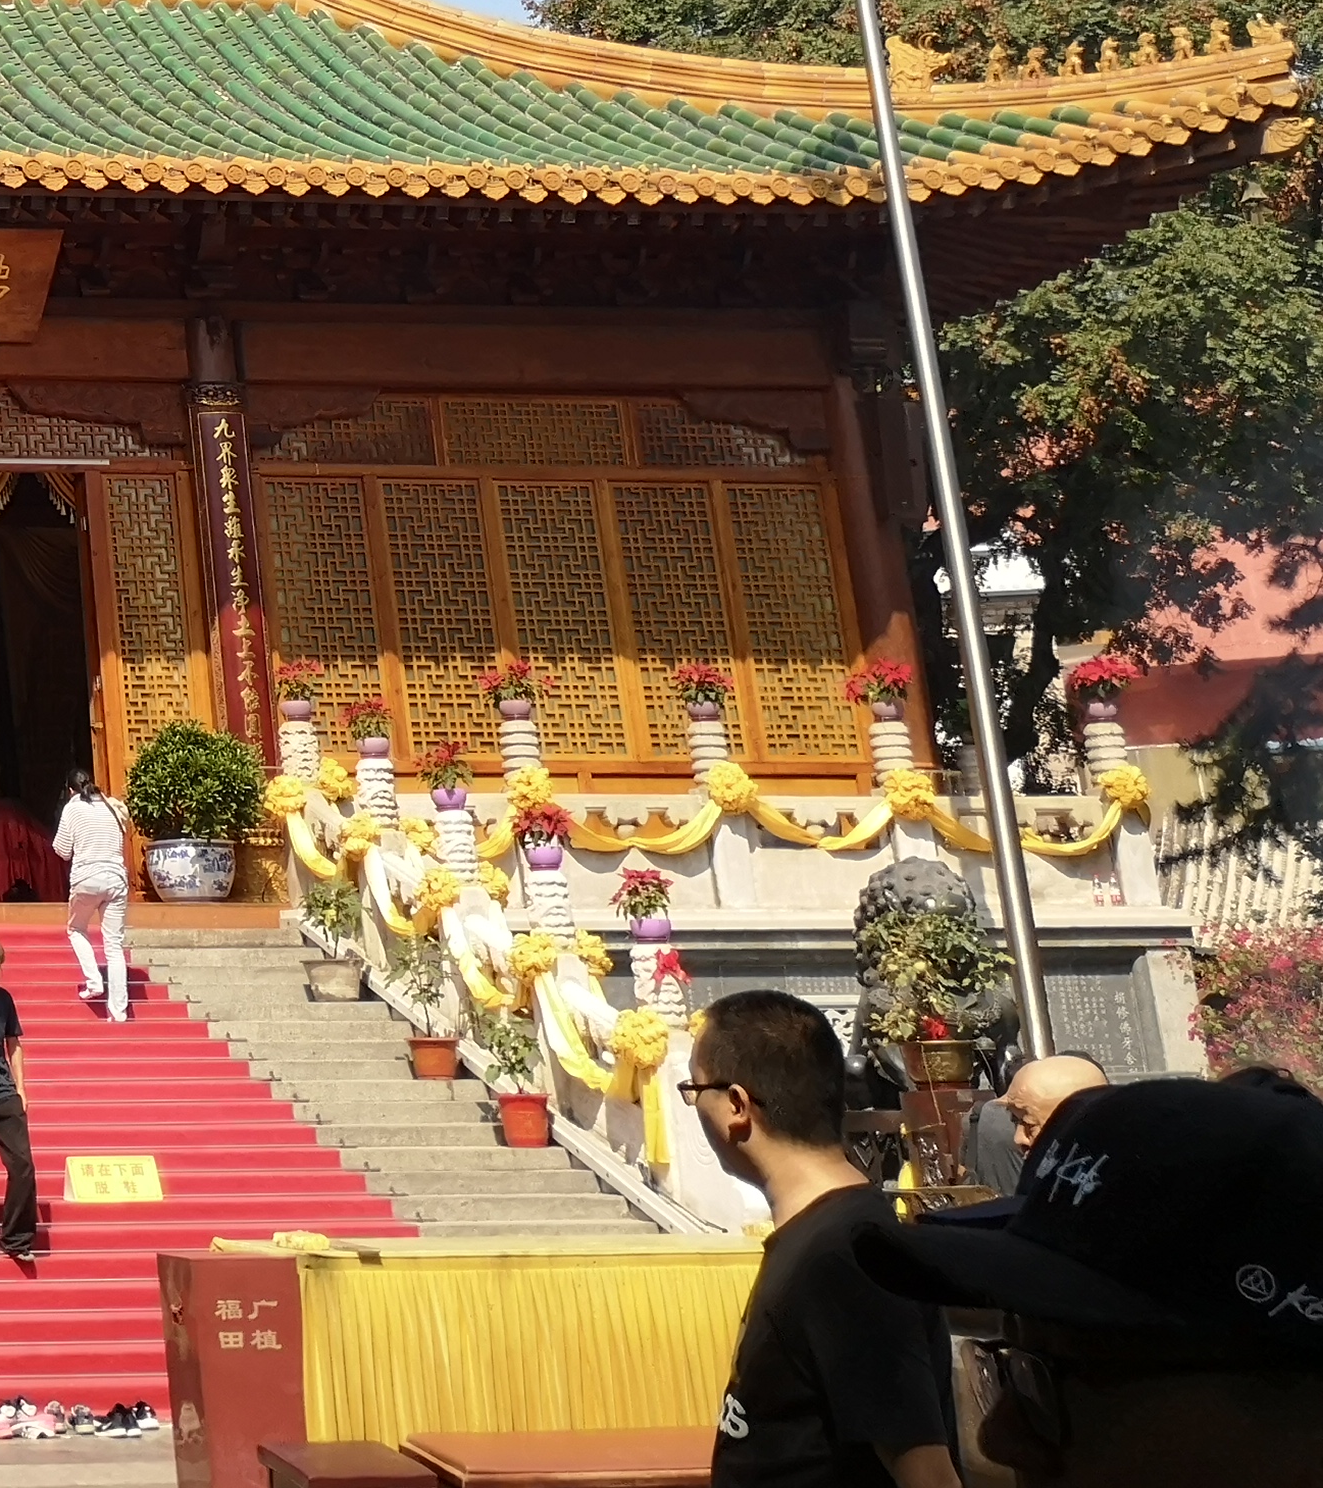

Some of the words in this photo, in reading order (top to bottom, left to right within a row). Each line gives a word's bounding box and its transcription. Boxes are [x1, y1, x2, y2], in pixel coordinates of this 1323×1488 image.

[80, 1162, 145, 1178] 请在下面
[94, 1180, 139, 1194] 脱鞋
